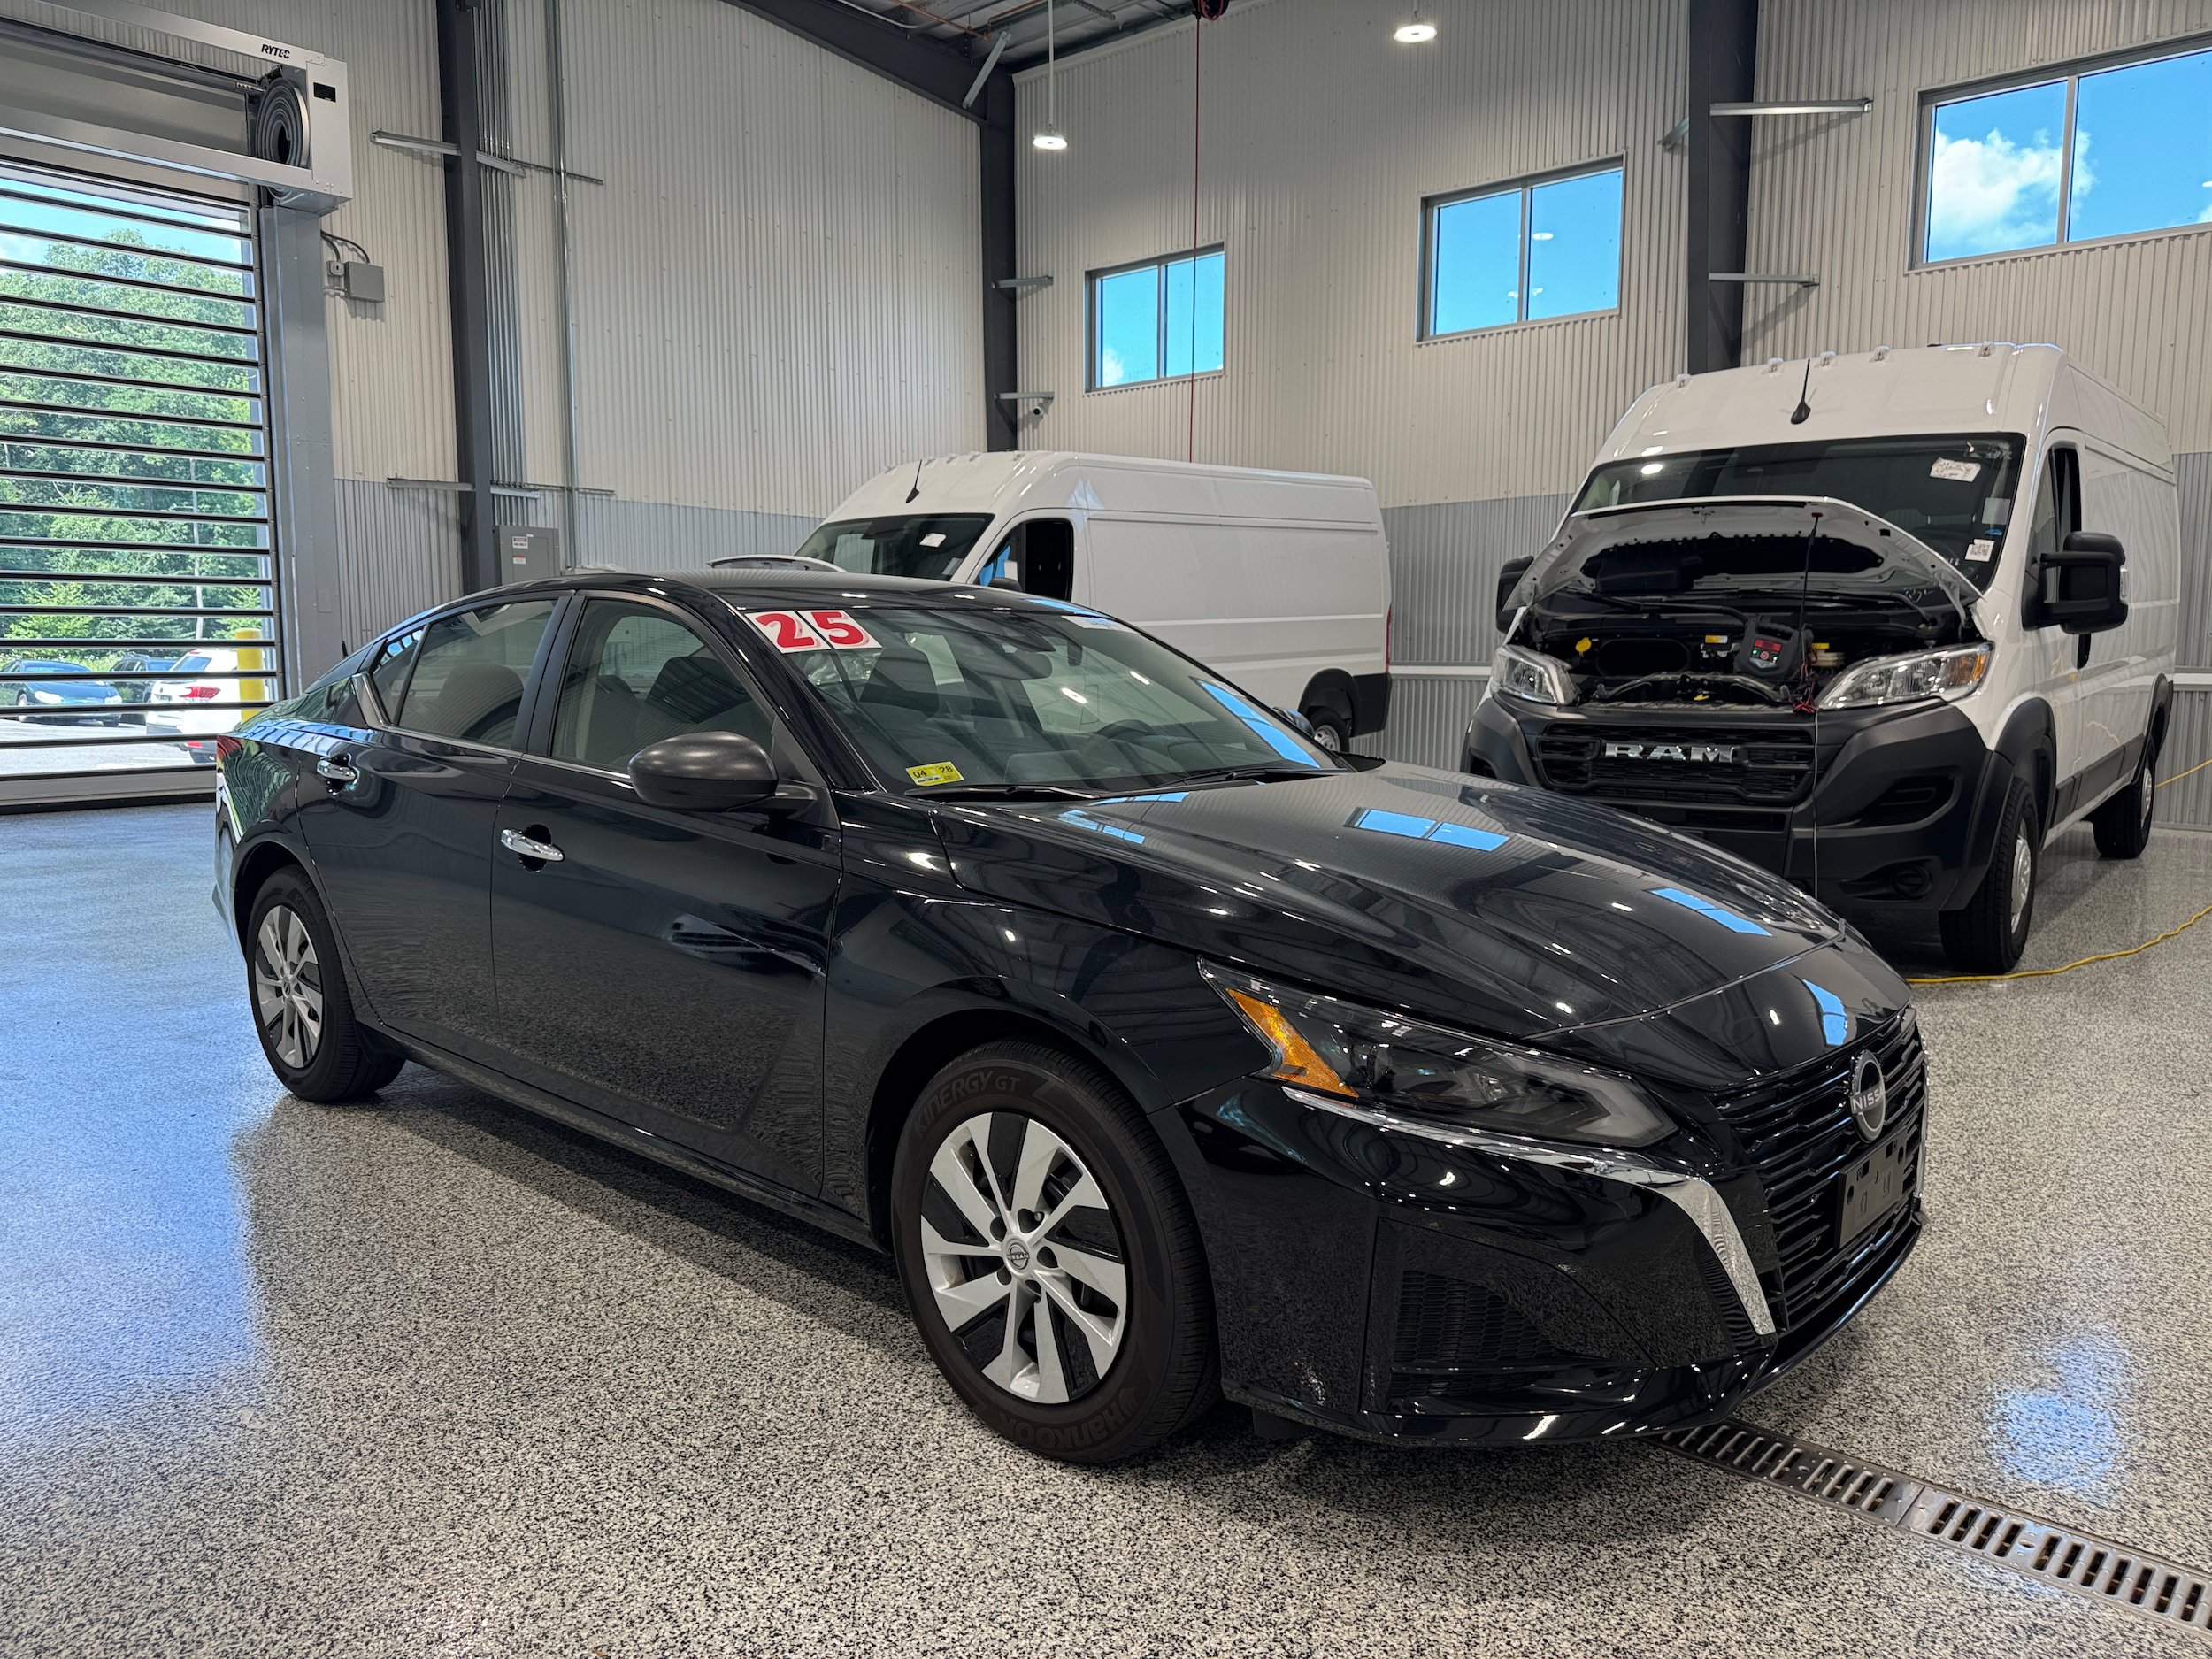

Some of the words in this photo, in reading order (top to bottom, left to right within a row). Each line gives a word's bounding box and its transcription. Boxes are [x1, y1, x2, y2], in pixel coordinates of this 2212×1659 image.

[260, 44, 290, 59] RYTEC
[755, 611, 870, 649] 25
[1605, 743, 1735, 763] RAM
[912, 770, 927, 779] 04
[939, 765, 953, 774] 28
[995, 1075, 1020, 1093] GT
[1852, 1085, 1885, 1111] NISSA
